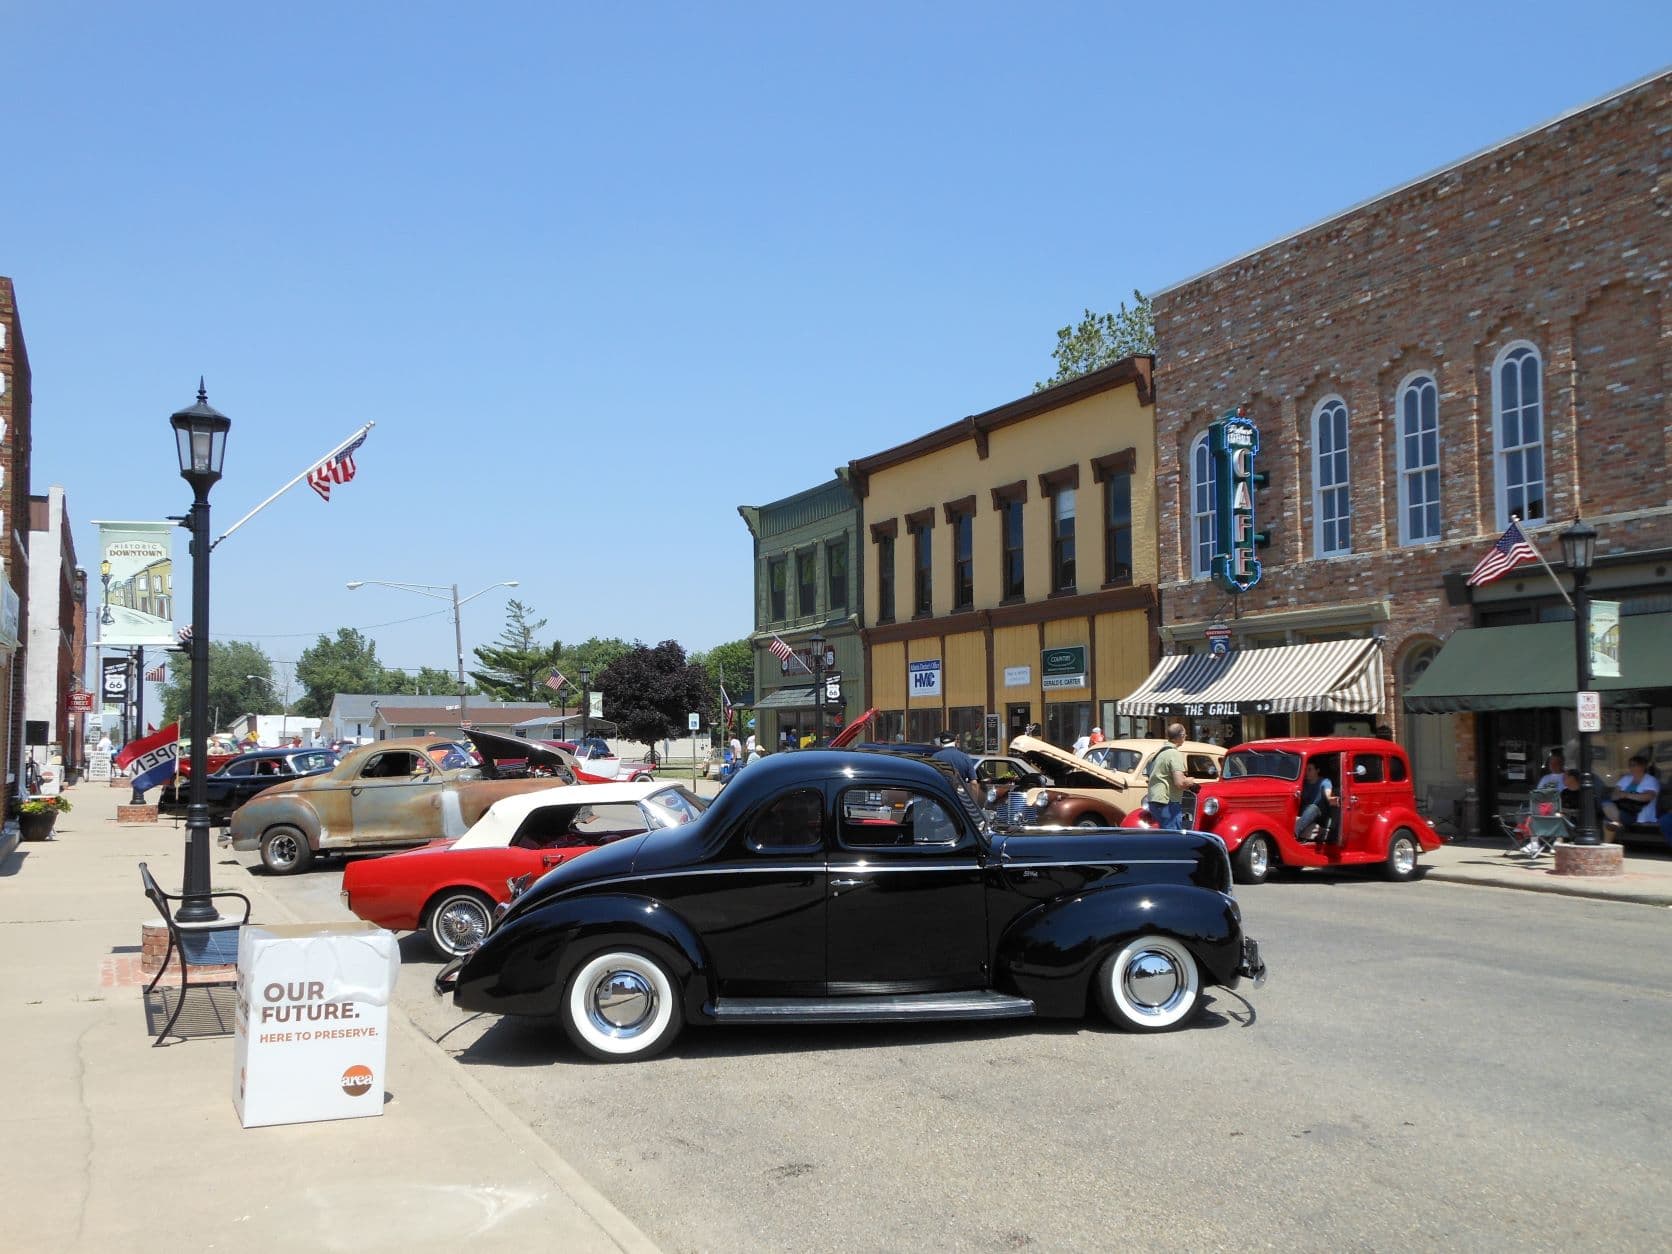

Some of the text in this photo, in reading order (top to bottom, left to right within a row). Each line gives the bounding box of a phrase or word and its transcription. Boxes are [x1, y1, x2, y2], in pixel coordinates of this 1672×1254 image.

[1232, 448, 1253, 576] CAFE
[109, 549, 163, 557] DOWNTOWN
[109, 681, 122, 689] 66
[914, 672, 935, 688] HMC
[1184, 702, 1241, 716] THE GRILL
[1583, 703, 1597, 711] HOUR
[1583, 720, 1596, 728] ONLY
[263, 981, 326, 1003] OUR
[260, 1002, 360, 1024] FUTURE.
[259, 1027, 379, 1044] HERE TO PRESERVE.
[341, 1074, 374, 1087] area
